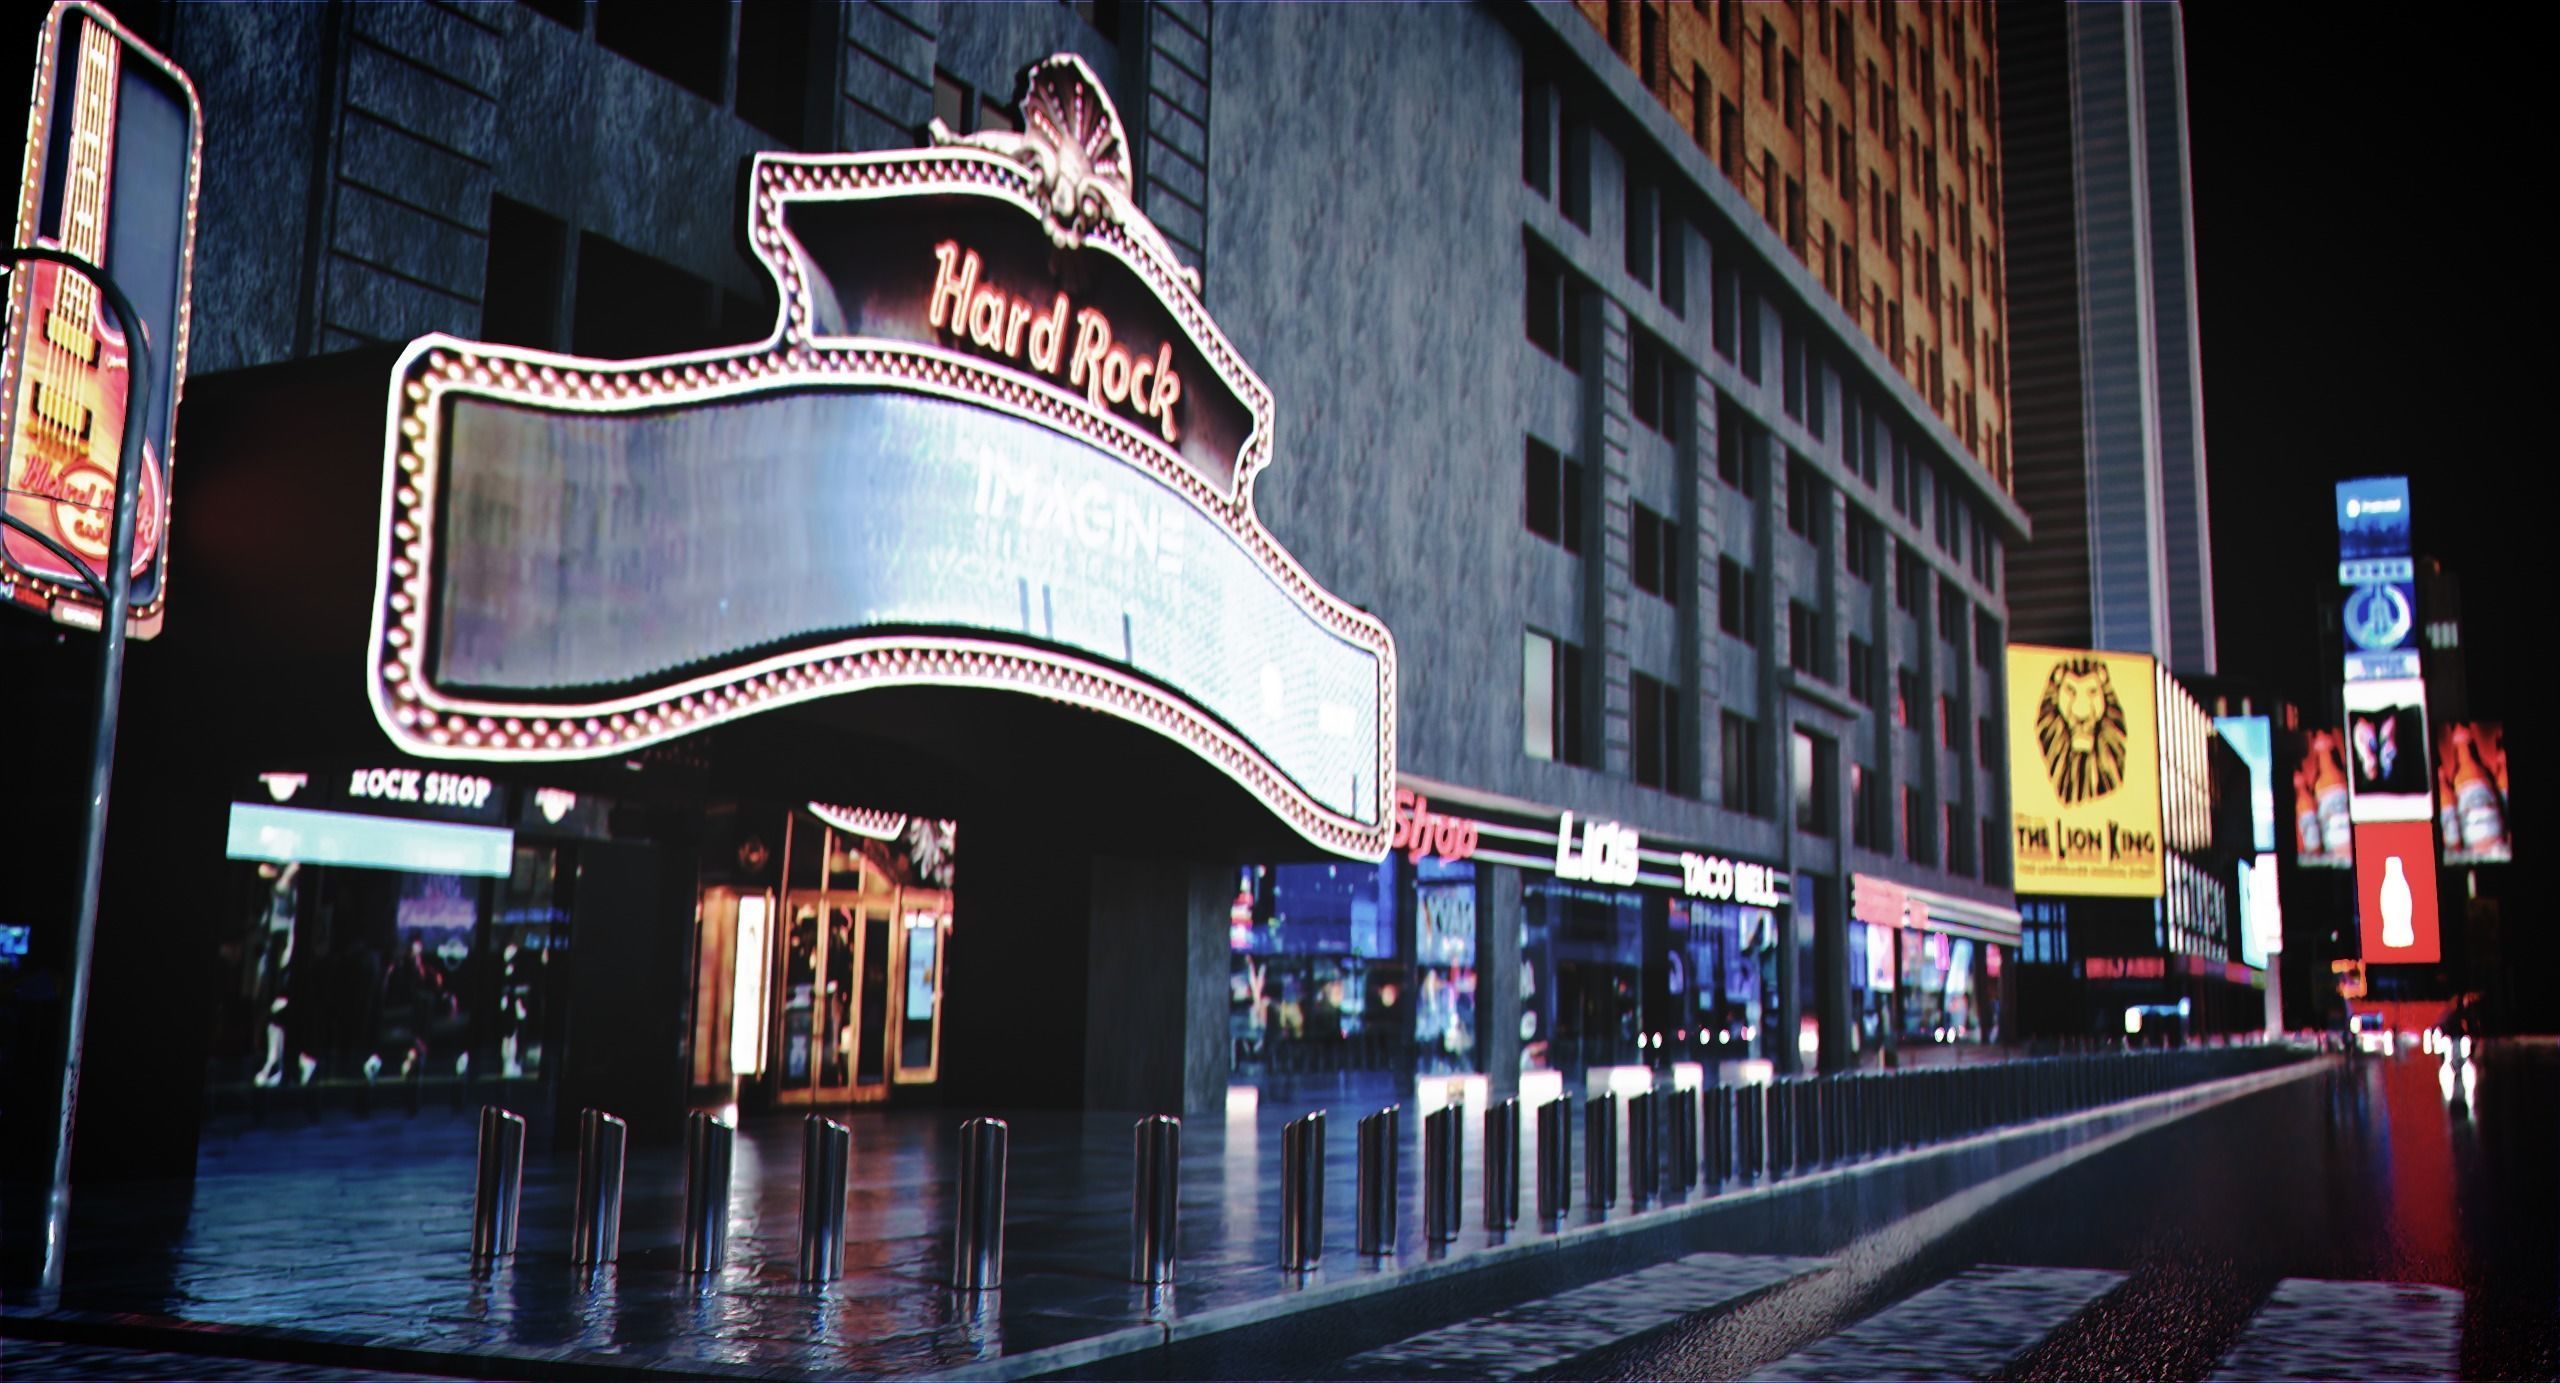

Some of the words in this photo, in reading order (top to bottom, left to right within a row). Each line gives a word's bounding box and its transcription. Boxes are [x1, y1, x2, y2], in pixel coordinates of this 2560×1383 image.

[929, 240, 1069, 374] Hard
[1070, 307, 1181, 443] Rock
[350, 768, 421, 802] ROCK
[423, 771, 492, 809] SHOP
[2018, 826, 2050, 850] THE
[1680, 851, 1733, 901] TACO
[1734, 860, 1780, 908] BELL
